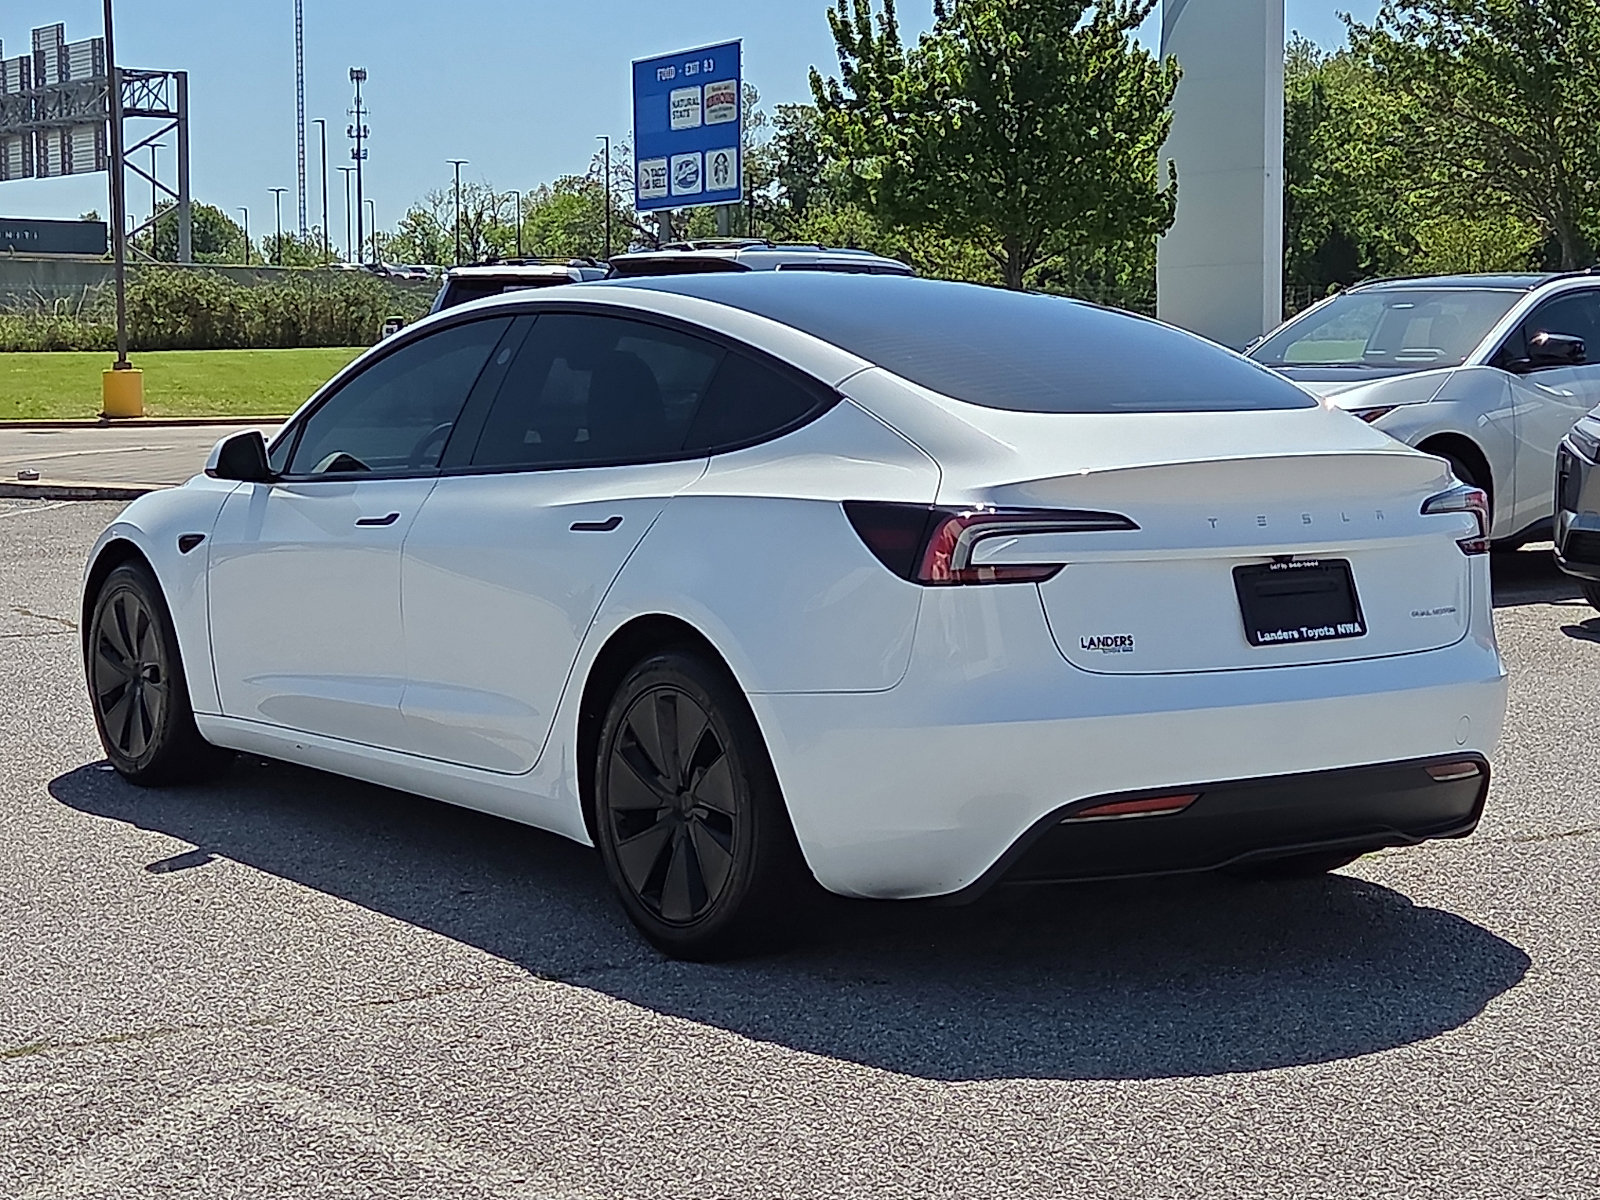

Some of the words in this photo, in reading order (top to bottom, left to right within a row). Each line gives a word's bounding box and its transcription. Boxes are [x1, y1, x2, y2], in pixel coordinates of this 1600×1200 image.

[657, 65, 676, 82] FOOD
[685, 61, 700, 76] EXIT
[671, 97, 700, 109] NATURAL
[672, 108, 690, 120] STATE
[651, 167, 666, 178] TACO
[652, 178, 666, 189] BELL
[1207, 510, 1384, 529] TESLA
[1257, 629, 1300, 642] Landers
[1300, 625, 1335, 639] Toyota
[1337, 622, 1362, 635] NWA
[1080, 634, 1133, 650] LANDERS
